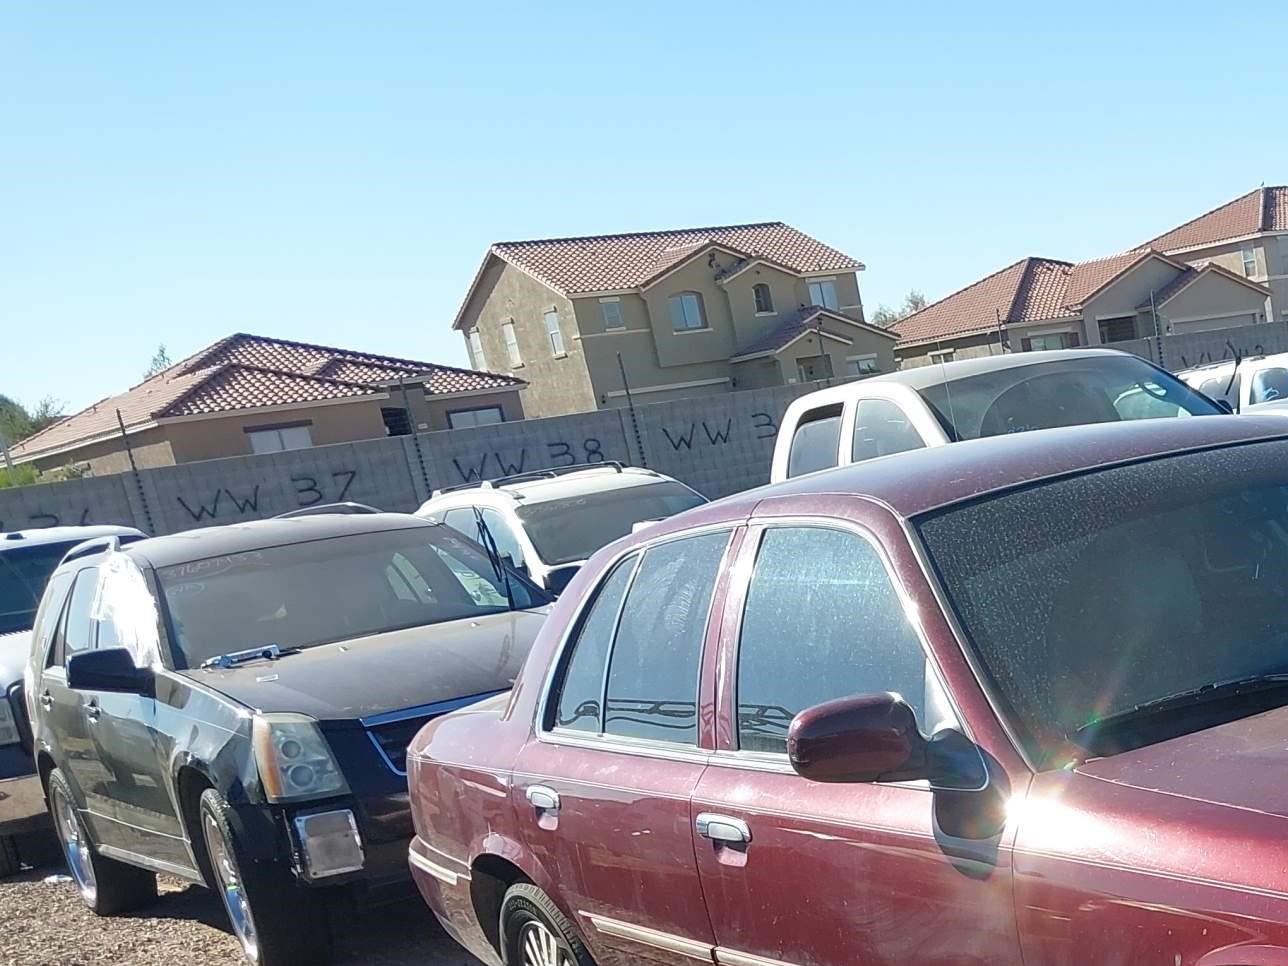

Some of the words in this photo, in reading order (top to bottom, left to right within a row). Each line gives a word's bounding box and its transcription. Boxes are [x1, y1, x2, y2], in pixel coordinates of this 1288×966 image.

[661, 416, 732, 452] WW
[751, 412, 778, 440] 3
[452, 447, 526, 483] WW
[546, 438, 605, 466] 38
[177, 484, 260, 523] WW
[290, 470, 357, 507] 37
